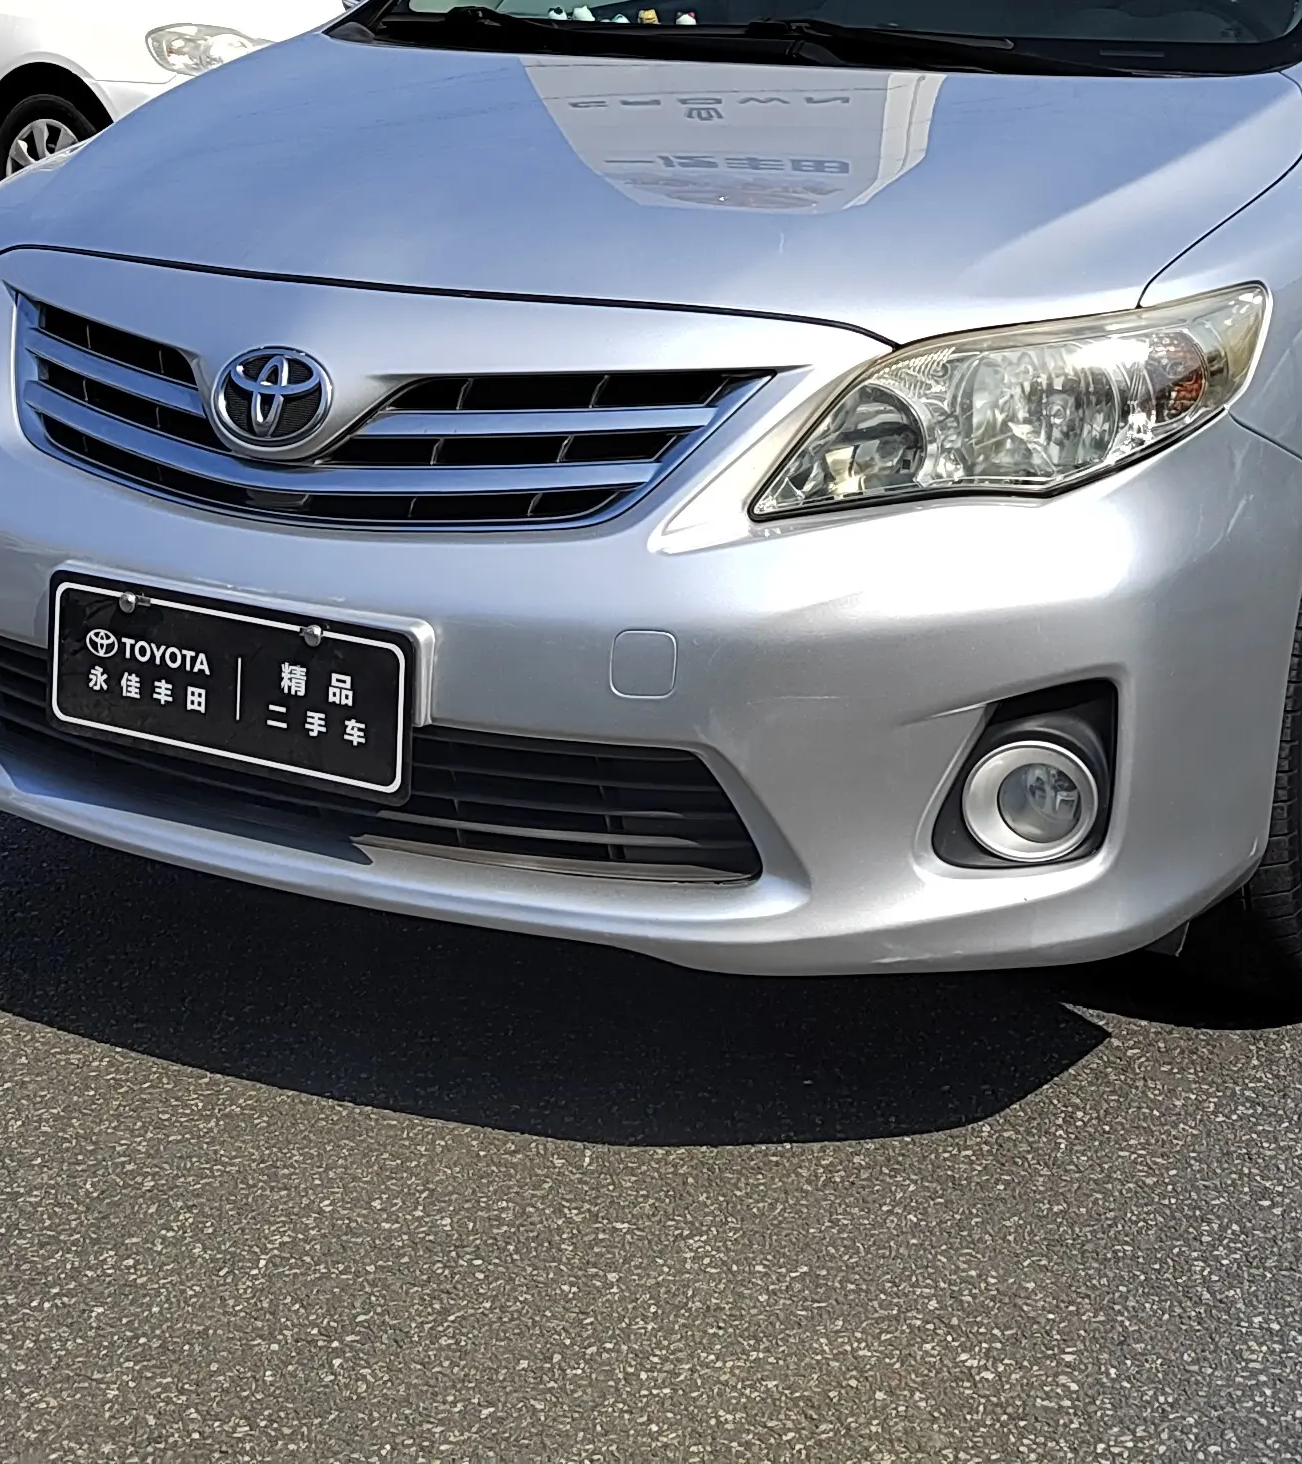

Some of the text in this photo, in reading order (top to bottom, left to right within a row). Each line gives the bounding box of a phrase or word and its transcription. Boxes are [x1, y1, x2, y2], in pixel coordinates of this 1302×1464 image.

[121, 637, 211, 676] TOYOTA
[88, 665, 207, 714] 永佳丰田
[280, 662, 353, 707] 精品
[266, 704, 366, 747] 二手车
